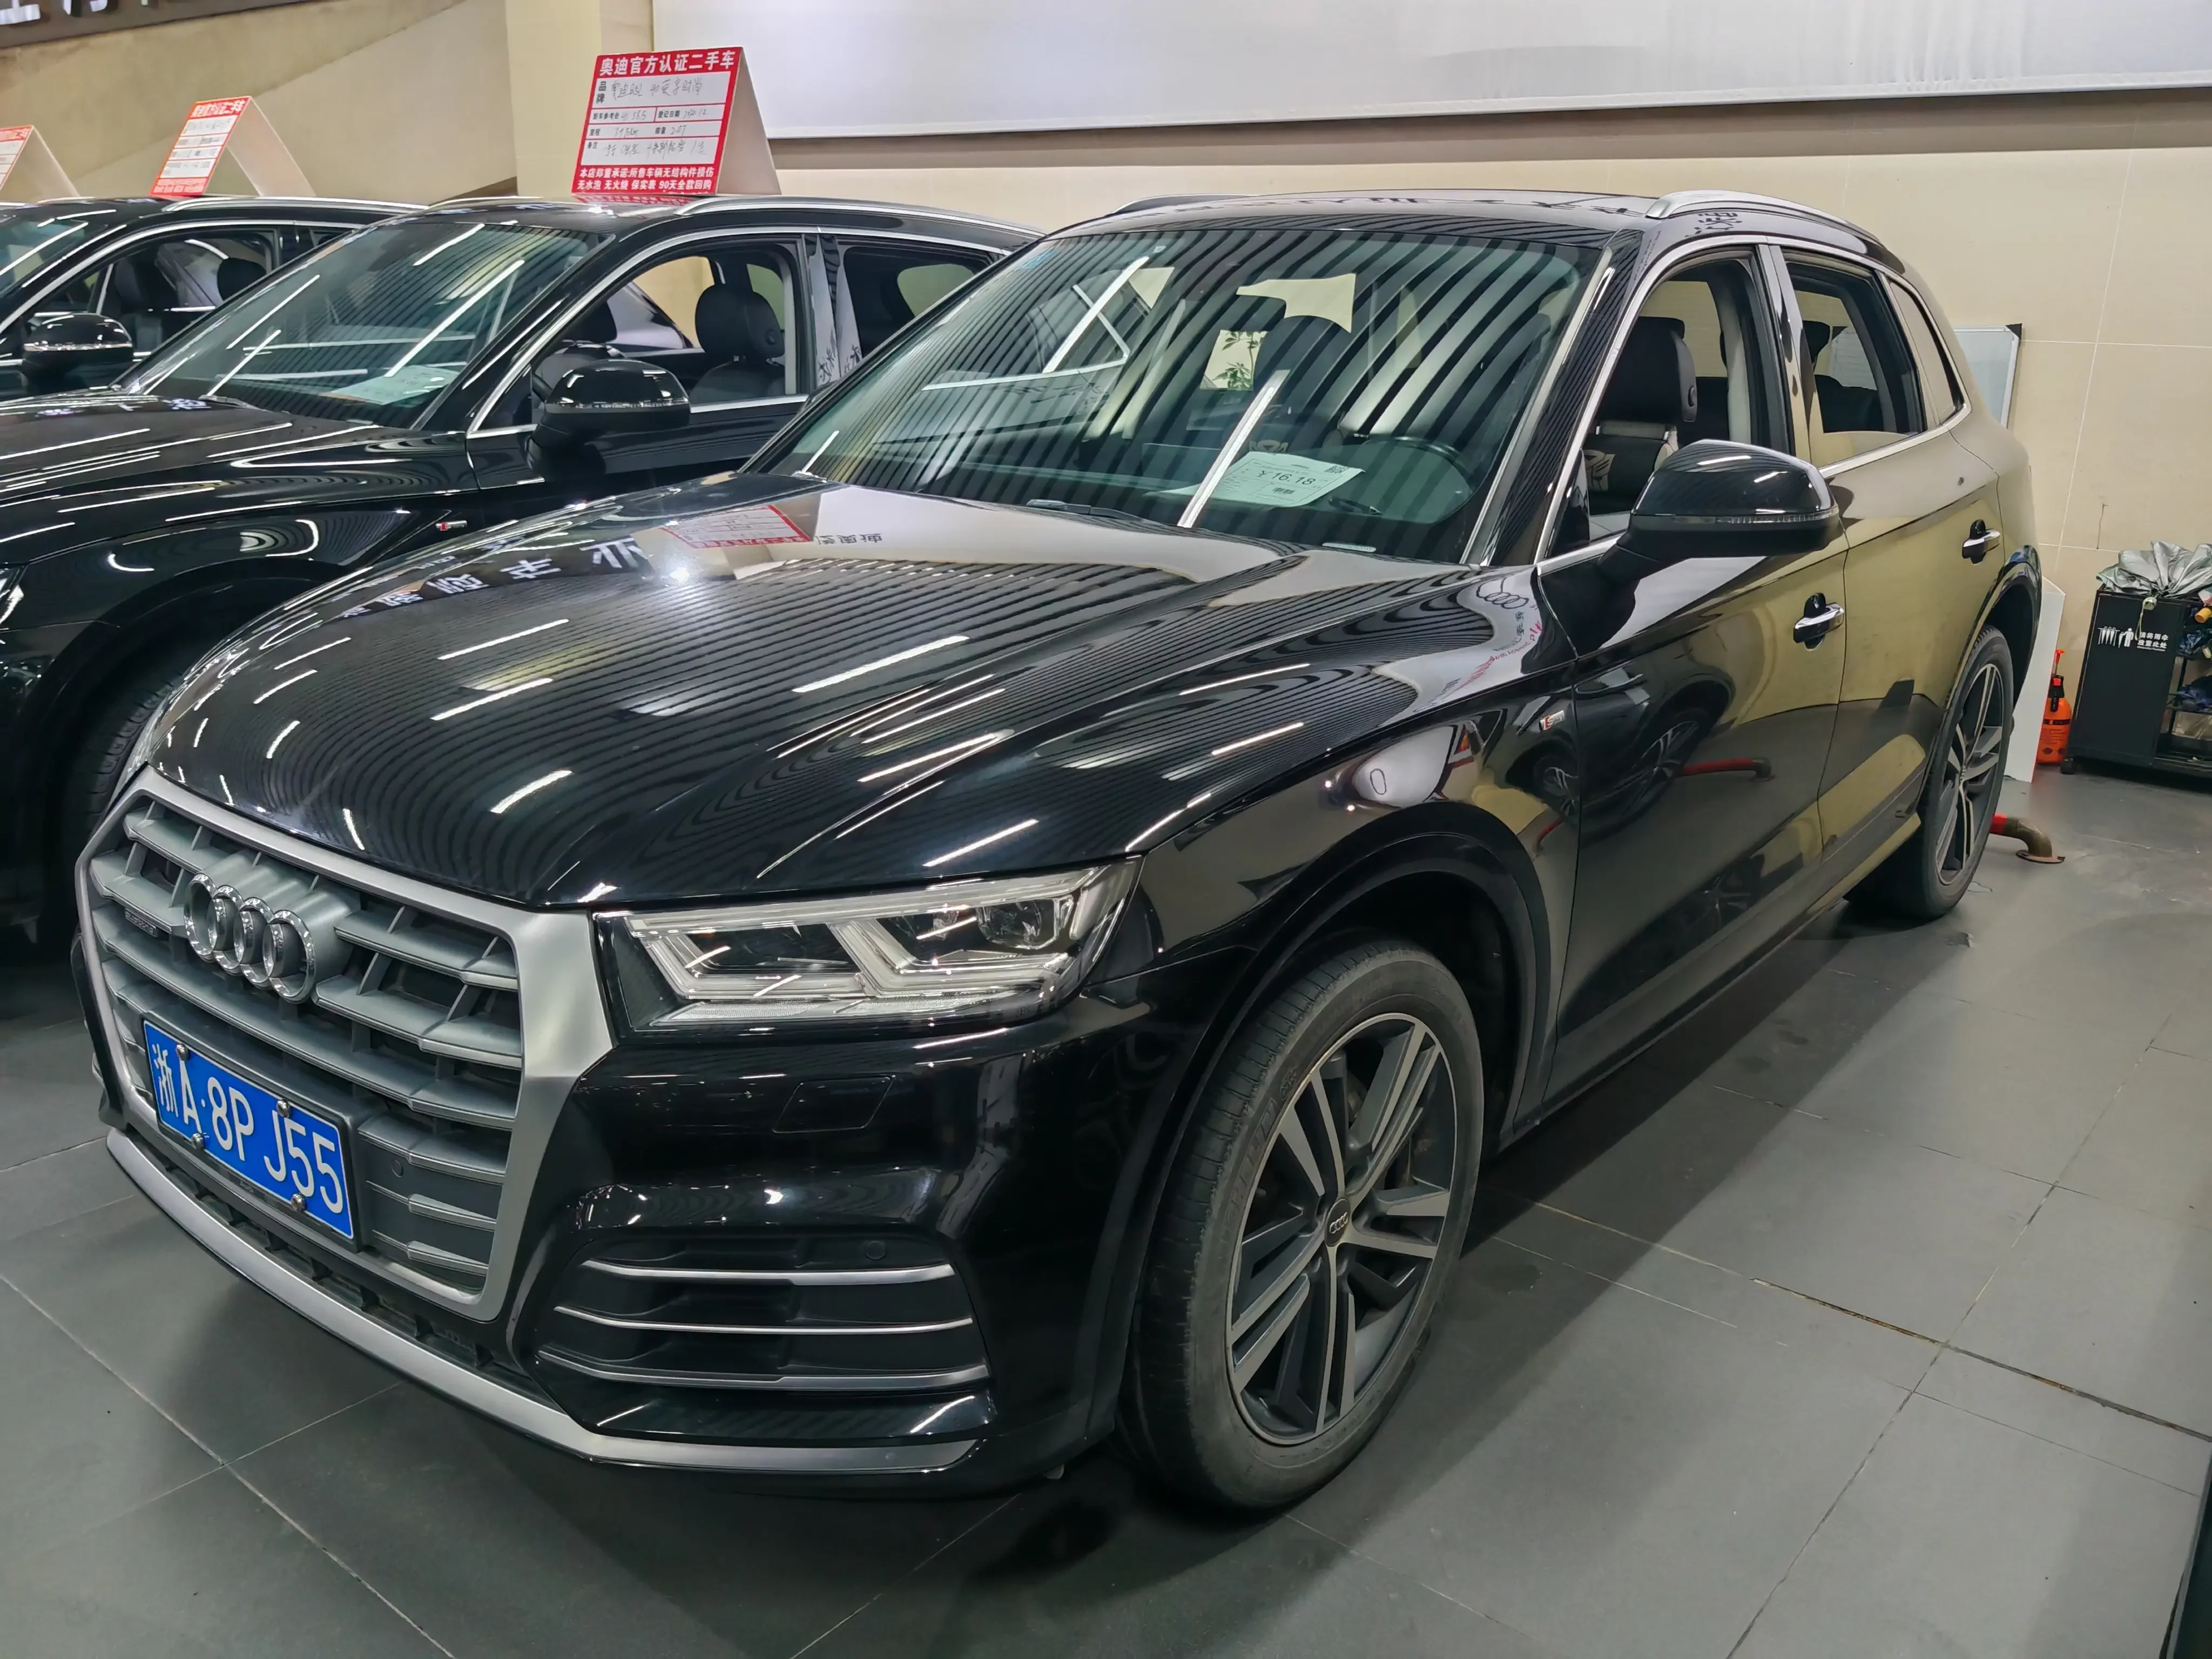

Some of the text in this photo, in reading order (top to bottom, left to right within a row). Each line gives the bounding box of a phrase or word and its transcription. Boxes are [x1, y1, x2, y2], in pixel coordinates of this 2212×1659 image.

[600, 51, 735, 75] 奥迪官方认证二手车
